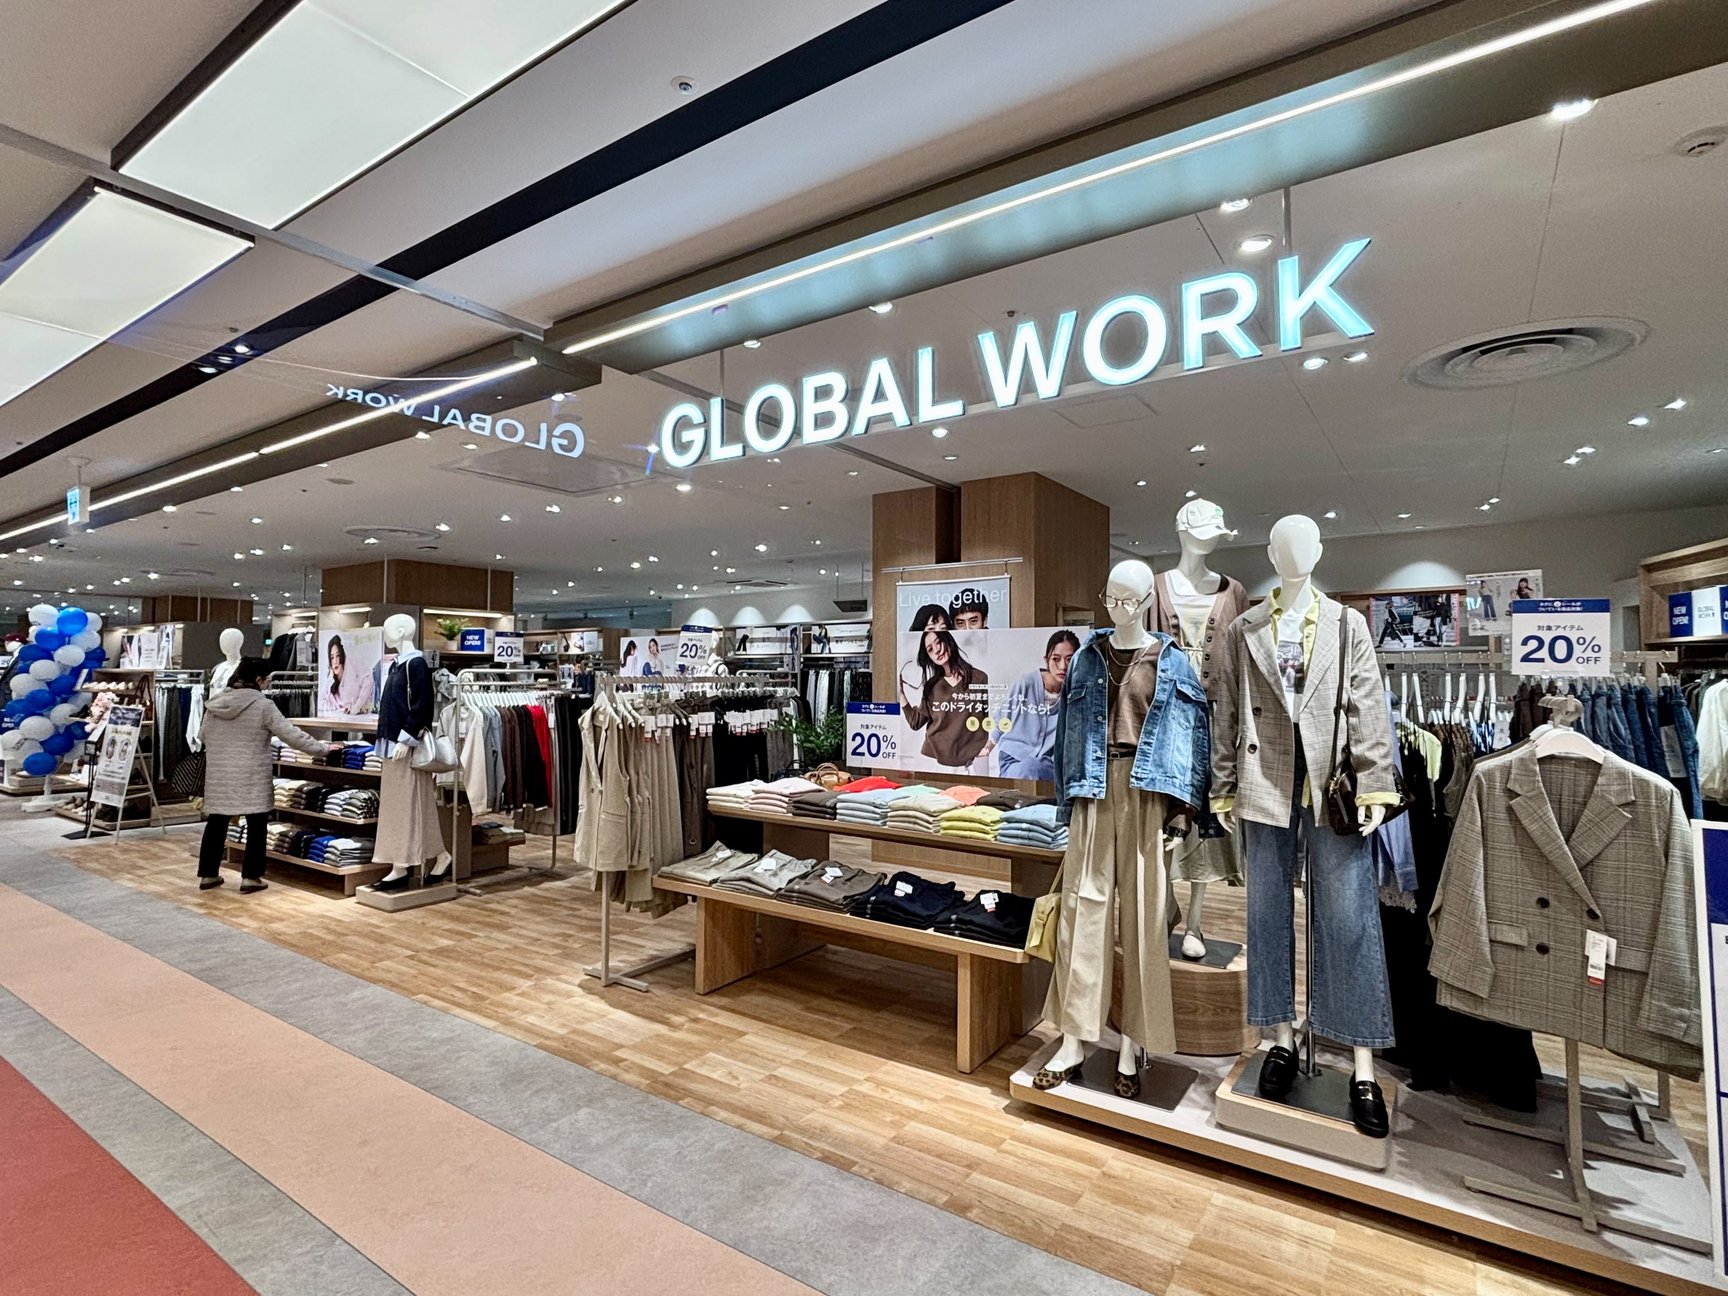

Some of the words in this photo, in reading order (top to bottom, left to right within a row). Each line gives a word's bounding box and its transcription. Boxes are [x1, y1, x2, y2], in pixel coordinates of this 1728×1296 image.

[660, 347, 965, 468] GLOBAL
[978, 237, 1375, 408] WORK
[900, 591, 929, 607] Live
[935, 587, 1007, 608] together
[497, 645, 521, 657] 20%
[680, 643, 707, 659] 20%
[1520, 635, 1602, 664] 20%
[1576, 656, 1602, 665] OFF
[932, 701, 1051, 715] このドライタッチニットなら!
[851, 732, 897, 758] 20%
[882, 752, 896, 760] OFF
